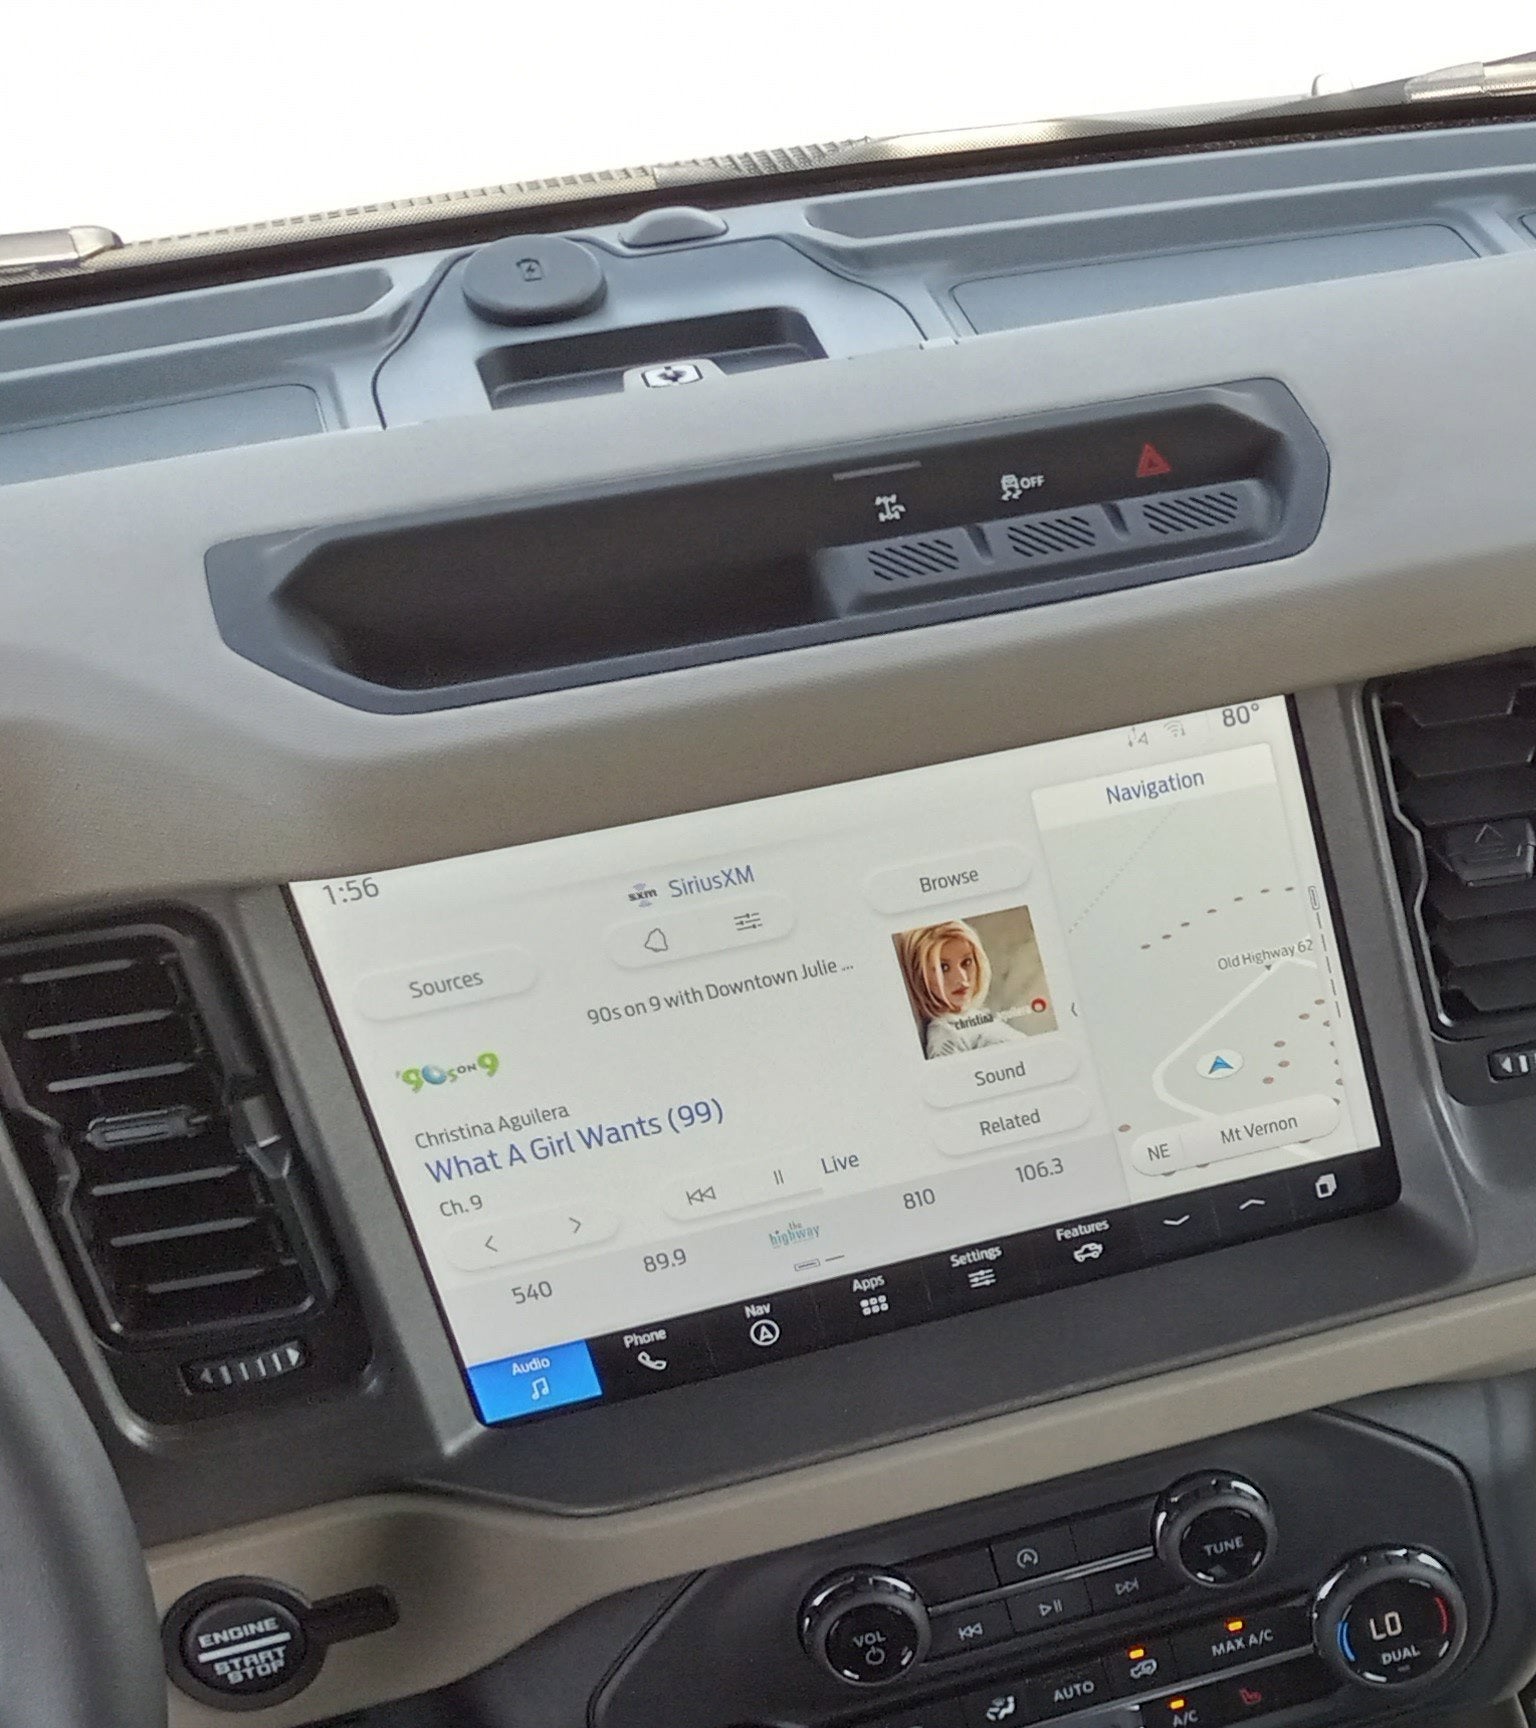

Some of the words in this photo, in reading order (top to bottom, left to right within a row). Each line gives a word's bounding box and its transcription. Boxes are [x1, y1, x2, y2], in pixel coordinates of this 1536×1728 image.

[1019, 474, 1046, 490] OFF
[1221, 702, 1261, 729] 80°
[1105, 770, 1206, 805] Navigation
[321, 876, 380, 908] 1:56
[628, 888, 658, 902] sxm
[668, 865, 755, 899] SiriusXM
[918, 868, 980, 894] Browse
[1217, 954, 1241, 971] Old
[1241, 944, 1296, 966] Highway
[1297, 938, 1314, 954] 62
[408, 969, 484, 1000] Sources
[586, 1005, 622, 1026] 90s
[624, 999, 648, 1018] on
[648, 995, 662, 1013] 9
[663, 987, 705, 1009] with
[705, 967, 800, 1001] Downtown
[801, 959, 838, 981] Julie
[974, 1060, 1027, 1087] Sound
[413, 1115, 496, 1151] Christina
[498, 1104, 571, 1133] Aguilera
[978, 1108, 1042, 1137] Related
[424, 1148, 503, 1184] What
[507, 1142, 528, 1168] A
[528, 1131, 577, 1162] Girl
[576, 1113, 664, 1152] Wants
[666, 1097, 725, 1134] (99)
[1146, 1143, 1172, 1163] NE
[1219, 1125, 1242, 1146] Mt
[1244, 1114, 1299, 1139] Vernon
[820, 1152, 861, 1176] Live
[438, 1198, 468, 1219] Ch.
[468, 1193, 484, 1212] 9
[510, 1279, 554, 1306] 540
[642, 1247, 688, 1275] 89.9
[902, 1187, 937, 1211] 810
[1014, 1156, 1065, 1184] 106.3
[768, 1225, 820, 1247] highway
[511, 1355, 552, 1377] Audio
[622, 1327, 668, 1350] Phone
[743, 1302, 772, 1320] Nav
[851, 1272, 886, 1293] Apps
[950, 1244, 1004, 1269] Settings
[1054, 1218, 1110, 1243] Features
[1203, 1536, 1245, 1558] TUNE
[197, 1616, 280, 1649] ENGINE
[852, 1630, 887, 1650] VOL
[1369, 1611, 1403, 1642] LO
[1211, 1638, 1247, 1657] MAX
[1247, 1627, 1275, 1648] A/C
[1381, 1644, 1422, 1667] DUAL
[213, 1646, 287, 1676] START
[226, 1658, 285, 1685] STOP
[1053, 1680, 1095, 1702] AUTO
[1172, 1708, 1199, 1728] A/C
